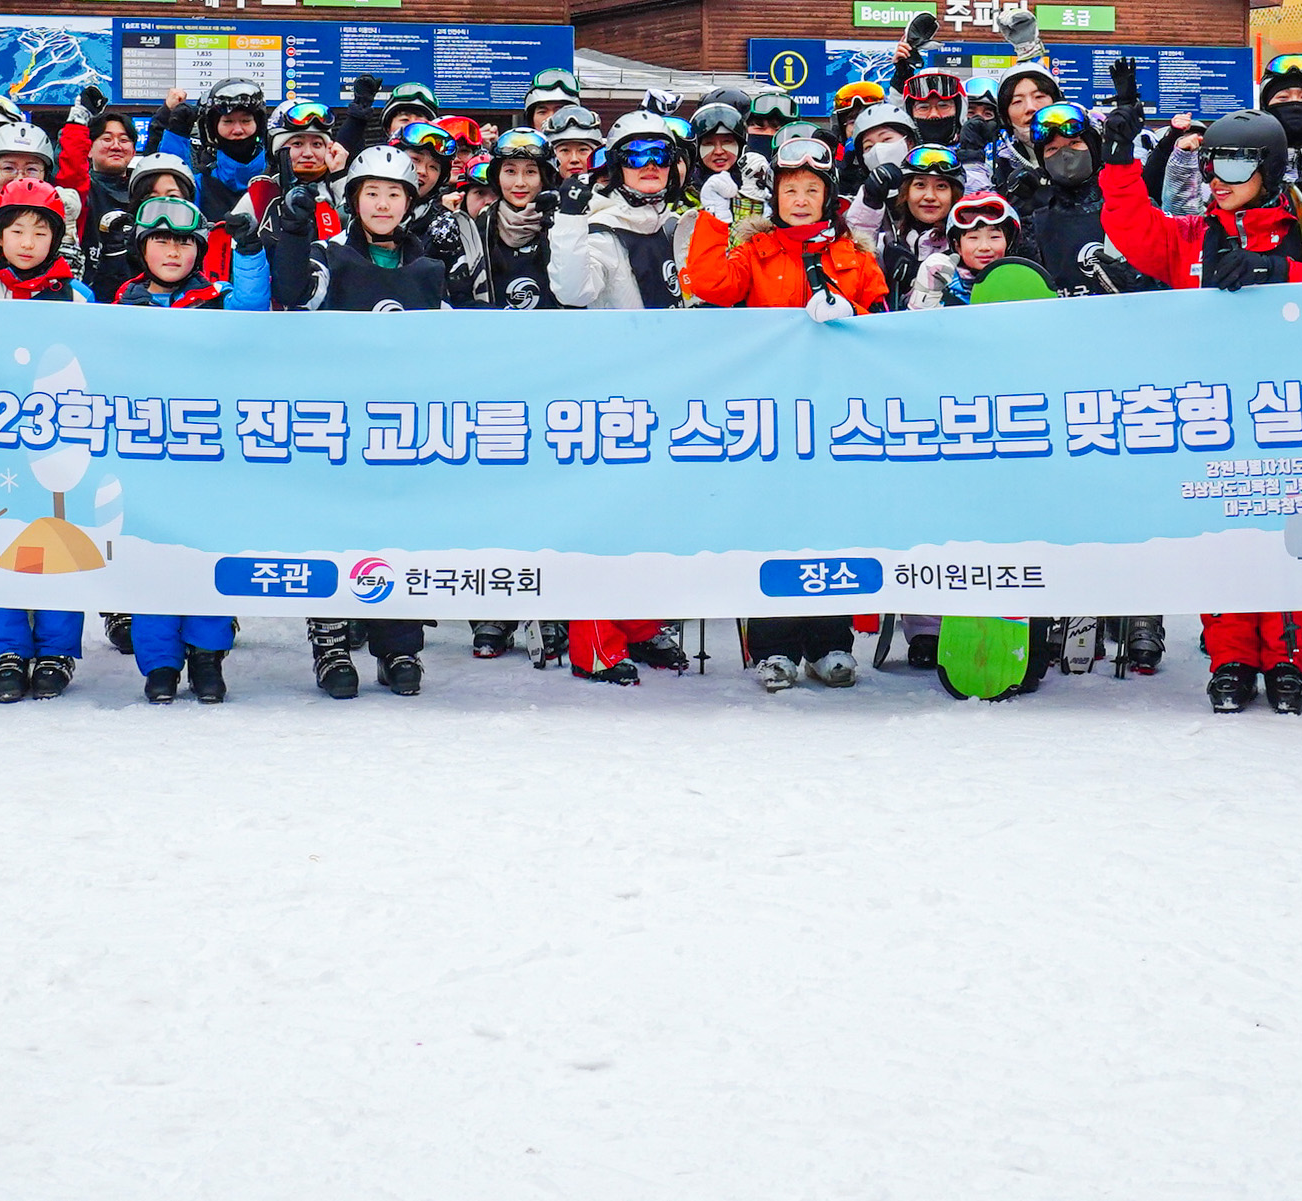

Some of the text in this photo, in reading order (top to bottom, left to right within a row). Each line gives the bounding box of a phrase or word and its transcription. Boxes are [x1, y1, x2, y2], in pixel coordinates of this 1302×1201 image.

[861, 6, 919, 23] Beginn
[1062, 9, 1091, 27] 초급
[236, 400, 348, 465] 전국
[362, 401, 532, 465] 교사를
[545, 396, 659, 465] 위한
[668, 398, 778, 463] 스키
[829, 392, 1053, 461] 스노보드
[1064, 381, 1235, 455] 맞춤형
[1181, 480, 1280, 498] 경상남도교육청
[250, 562, 312, 593] 주관
[357, 575, 387, 587] KEA
[405, 567, 542, 596] 한국체육회
[798, 562, 860, 593] 장소
[894, 563, 1046, 591] 하이원리조트
